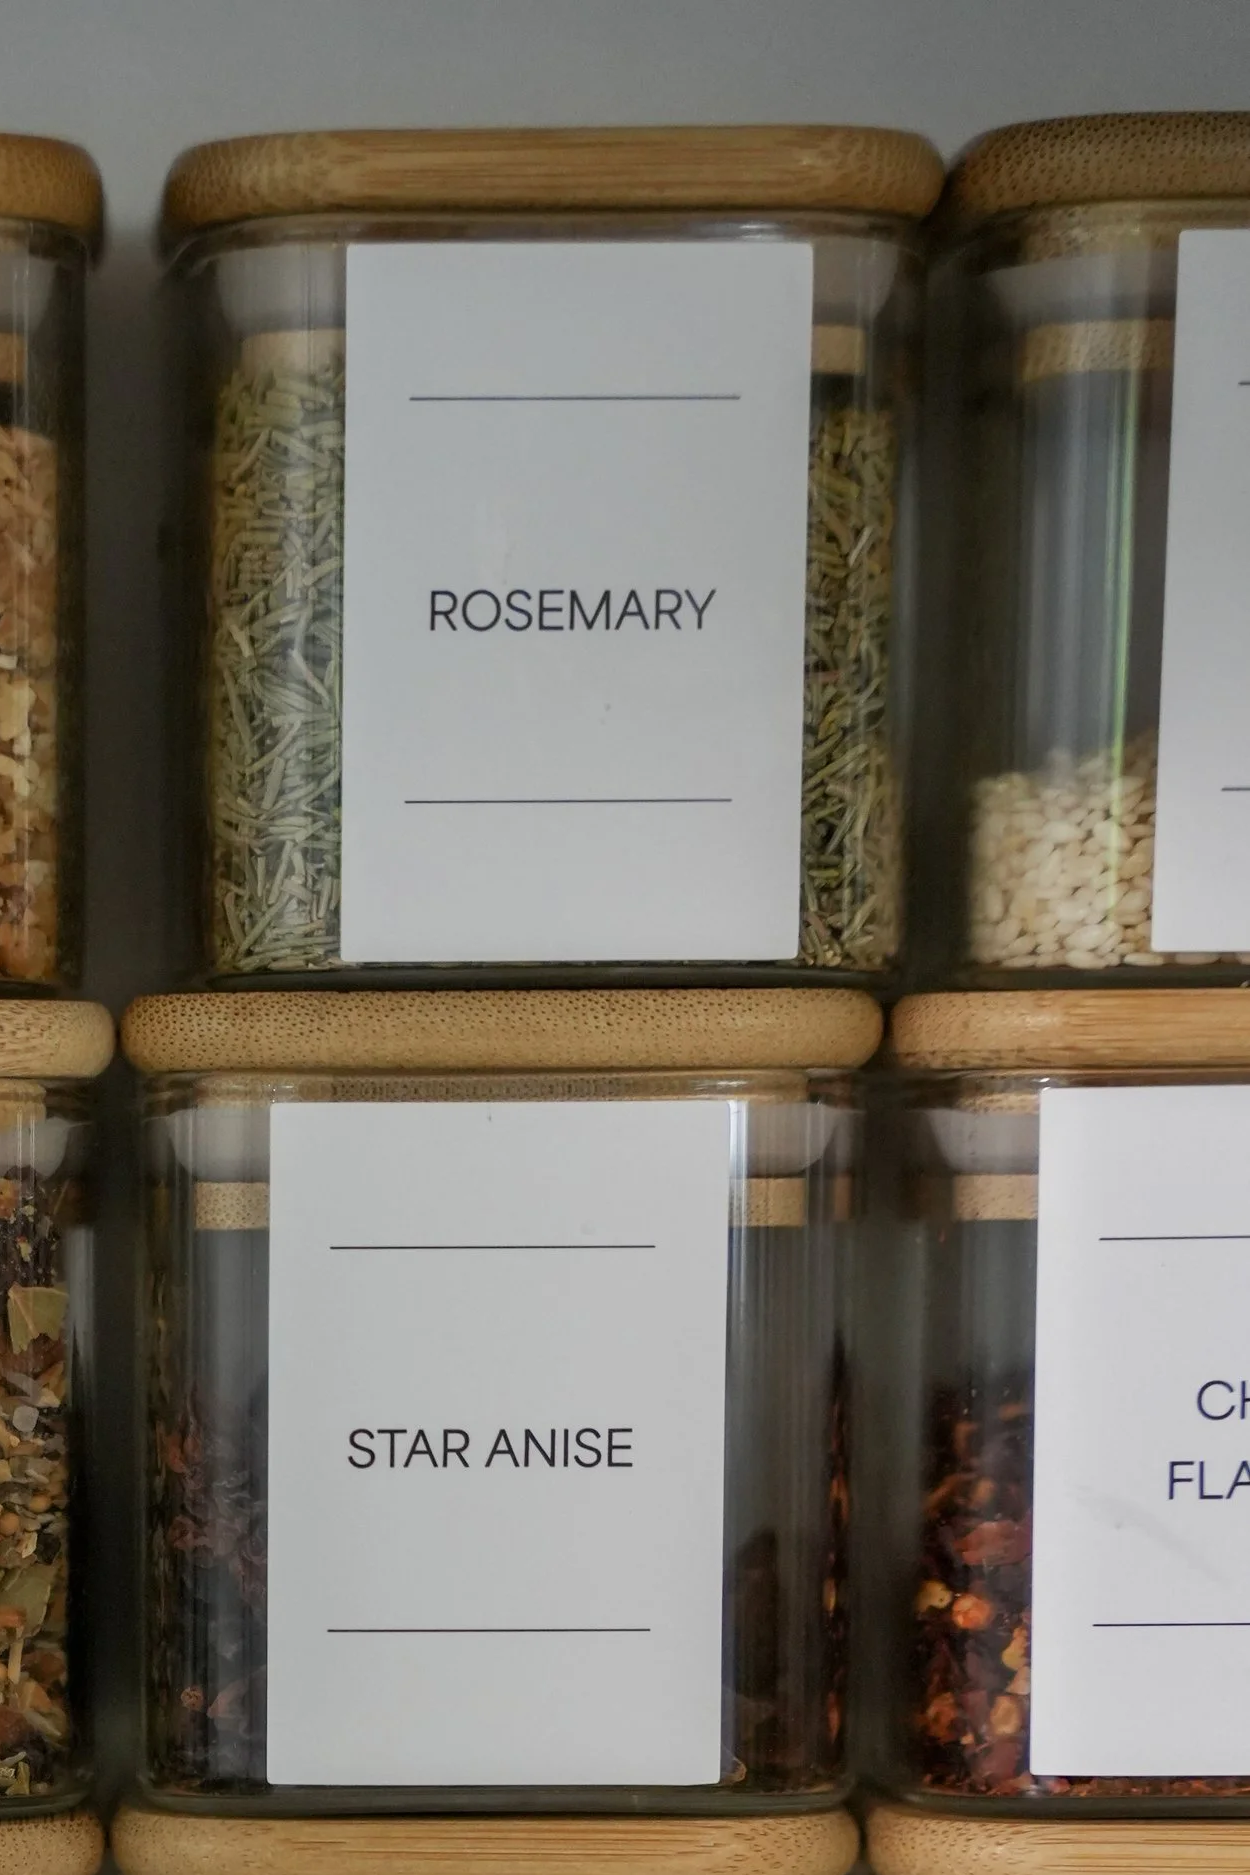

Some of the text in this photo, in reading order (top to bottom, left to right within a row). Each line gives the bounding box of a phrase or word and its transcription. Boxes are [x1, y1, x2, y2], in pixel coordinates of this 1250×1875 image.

[430, 589, 716, 632] ROSEMARY
[348, 1428, 633, 1469] STAR ANISE
